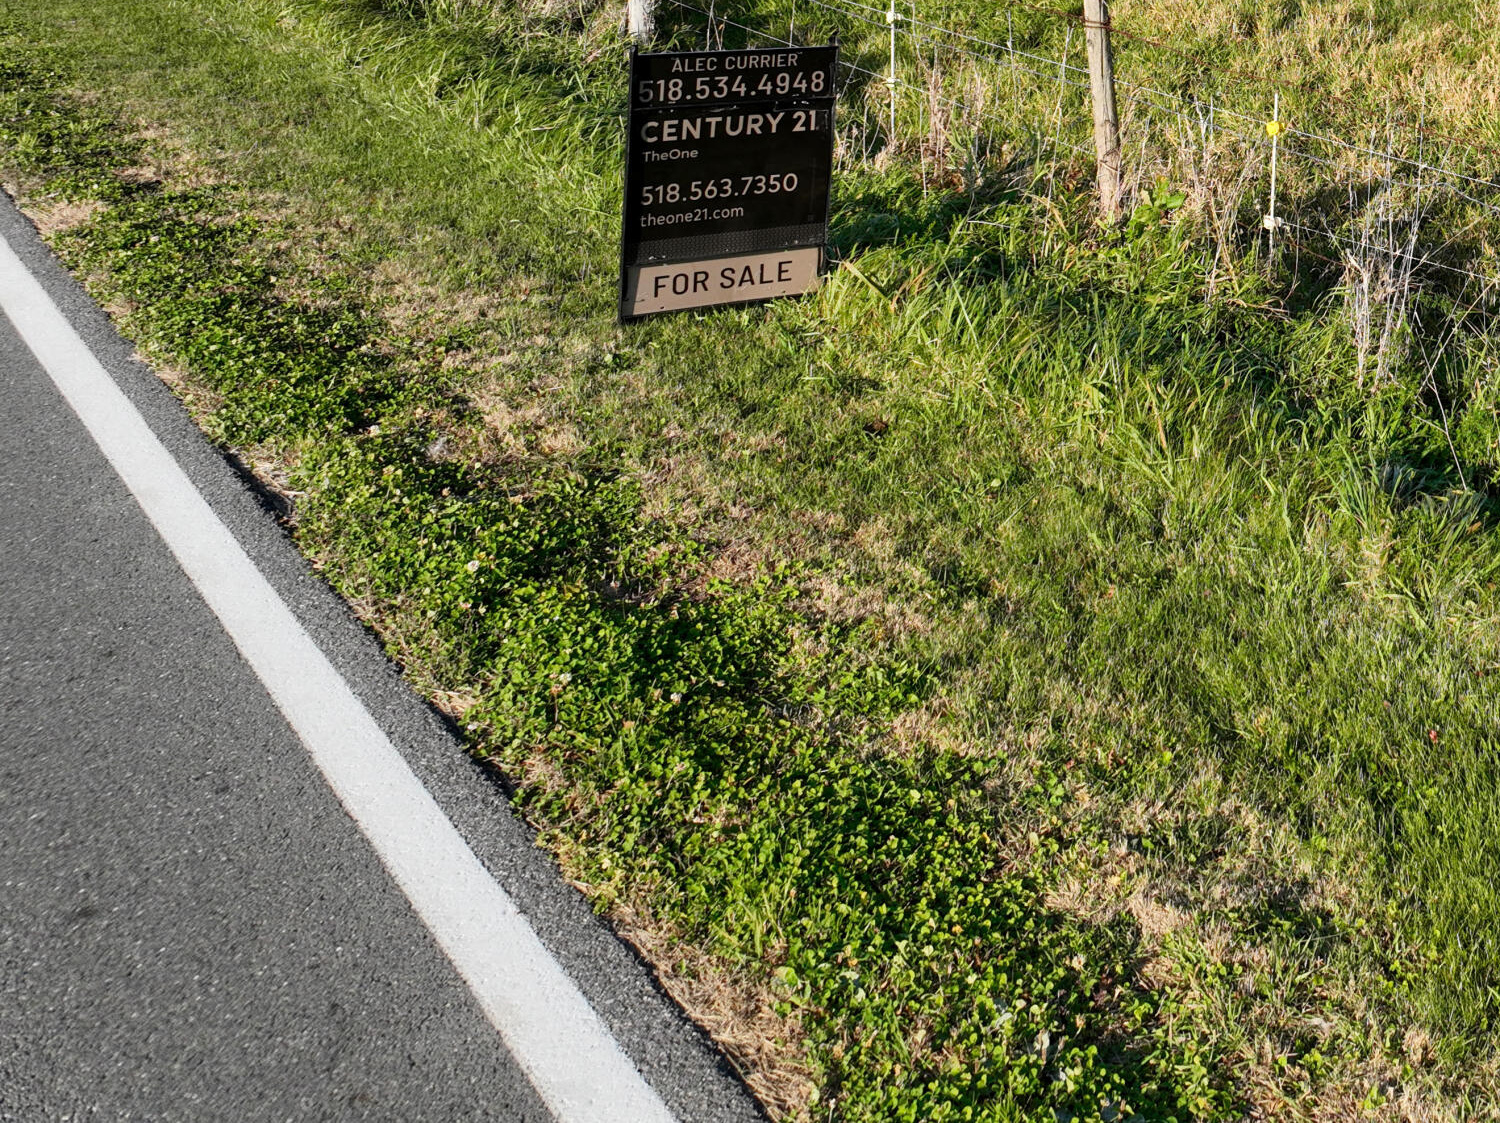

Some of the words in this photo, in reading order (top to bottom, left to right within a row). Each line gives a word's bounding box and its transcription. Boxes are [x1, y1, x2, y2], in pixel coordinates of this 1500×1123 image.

[671, 57, 718, 73] ALEC
[725, 53, 798, 70] CURRIER
[639, 71, 825, 103] 518.534.4948
[640, 112, 785, 143] CENTURY
[792, 110, 817, 132] 21
[642, 148, 699, 163] TheOne
[640, 173, 798, 206] 518.563.7350
[640, 206, 744, 227] theone21.com
[653, 270, 709, 298] FOR
[720, 261, 793, 289] SALE
